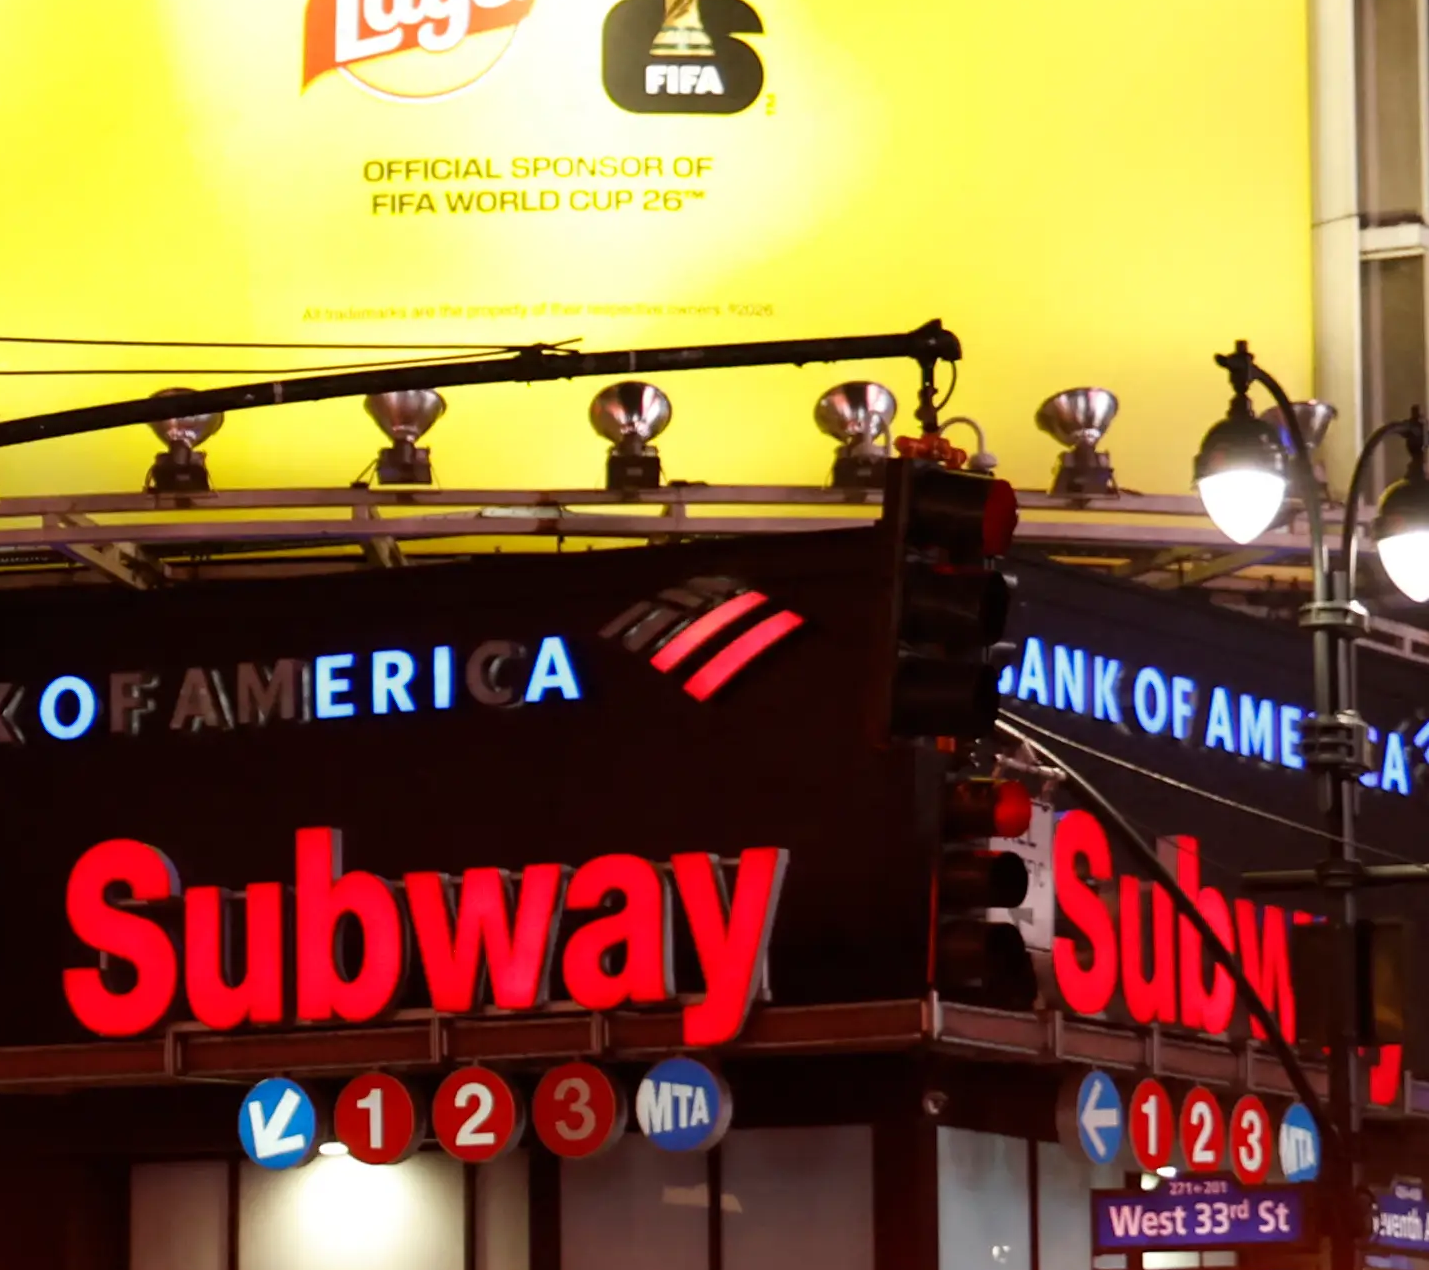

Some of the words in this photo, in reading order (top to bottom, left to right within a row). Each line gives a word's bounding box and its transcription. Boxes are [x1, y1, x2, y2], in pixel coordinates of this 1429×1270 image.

[646, 65, 723, 95] FIFA
[363, 158, 501, 183] OFFICIAL
[511, 156, 664, 180] SPONSOR
[672, 156, 712, 178] OF
[372, 192, 437, 214] FIFA
[445, 190, 560, 213] WORLD
[569, 189, 632, 211] CUP
[39, 671, 154, 742] OF
[172, 635, 580, 732] AMERICA
[998, 637, 1120, 724] ANK
[1134, 667, 1195, 740] OF
[1205, 688, 1409, 795] AMEA
[62, 826, 783, 1046] Subway
[454, 1082, 496, 1148] 2
[552, 1078, 597, 1141] 3
[636, 1078, 710, 1136] MTA
[1108, 1203, 1186, 1238] West
[1258, 1199, 1290, 1234] St
